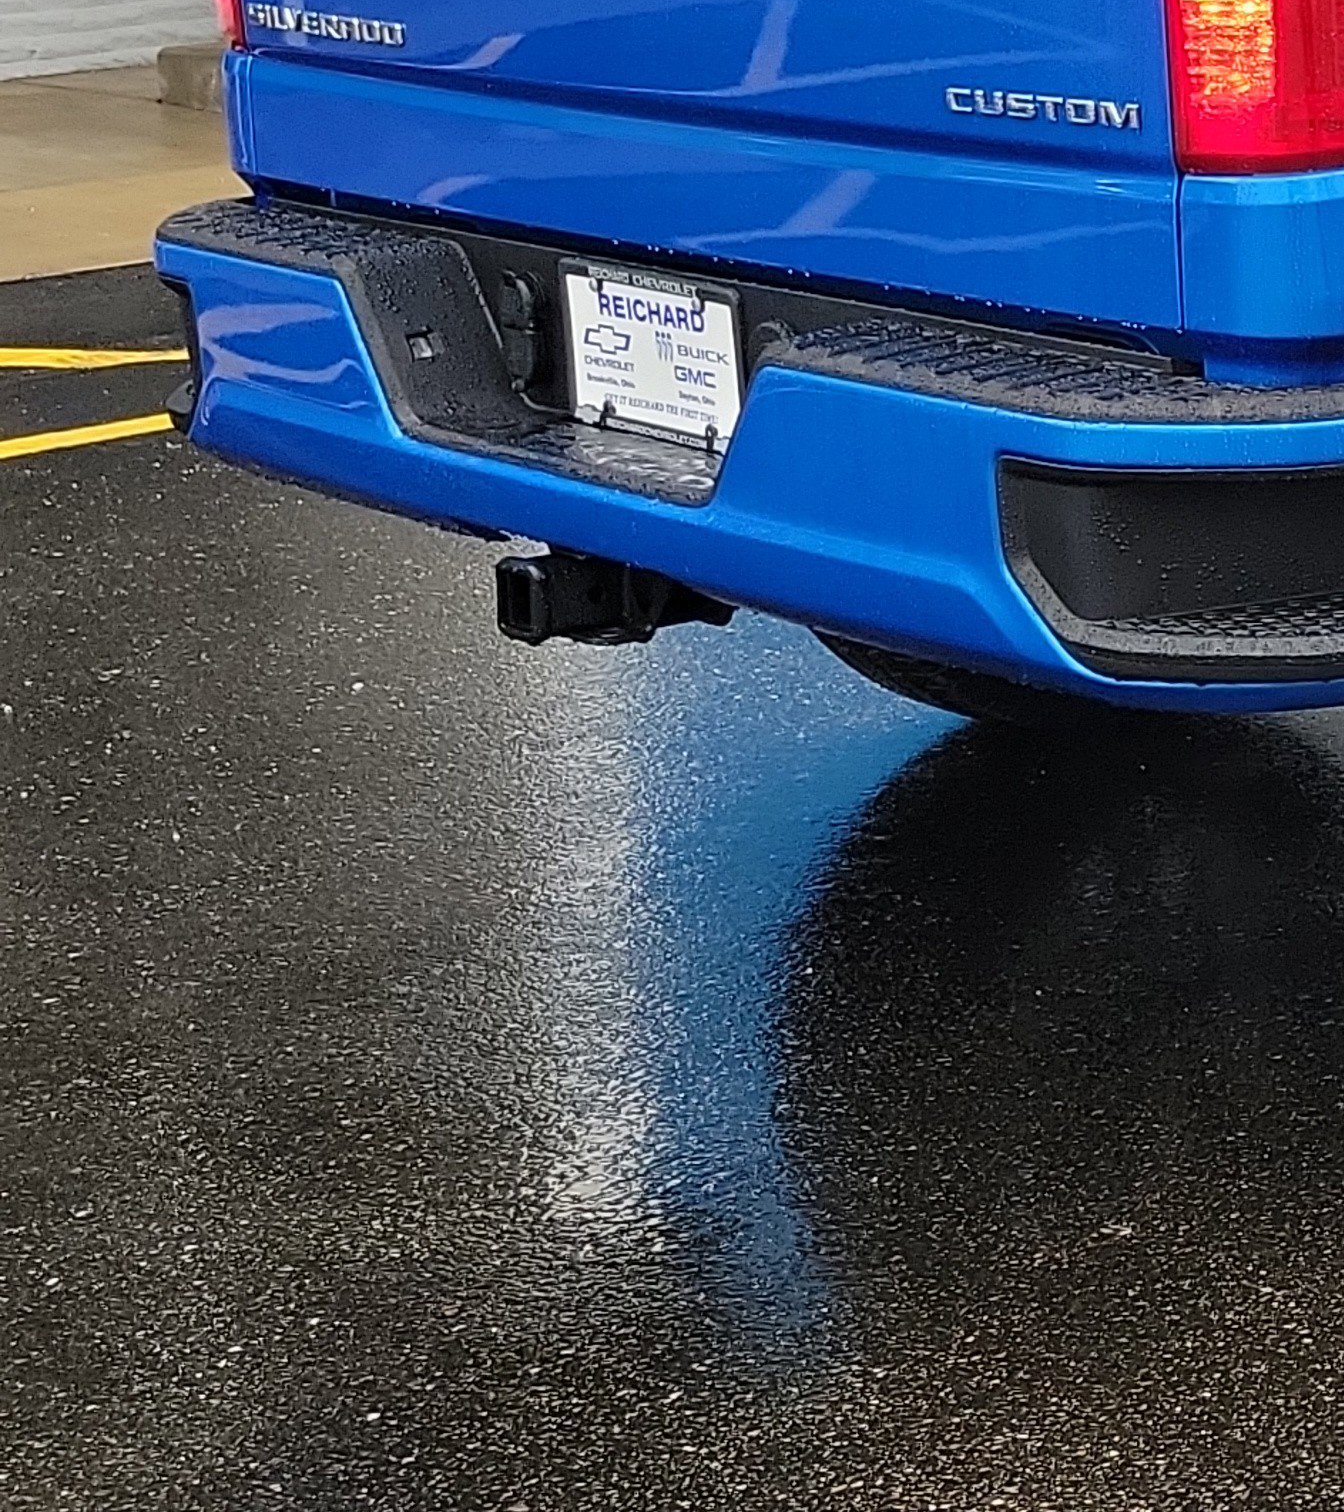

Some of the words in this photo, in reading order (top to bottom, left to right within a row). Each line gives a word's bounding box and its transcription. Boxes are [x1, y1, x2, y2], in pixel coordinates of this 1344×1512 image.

[248, 2, 407, 46] SILVERADO
[946, 86, 1141, 130] CUSTOM
[632, 274, 698, 299] CHEVROLET
[597, 292, 705, 333] REICHARD
[584, 354, 635, 373] CHEVROLET
[677, 343, 730, 367] BUICK
[674, 364, 717, 389] GMC
